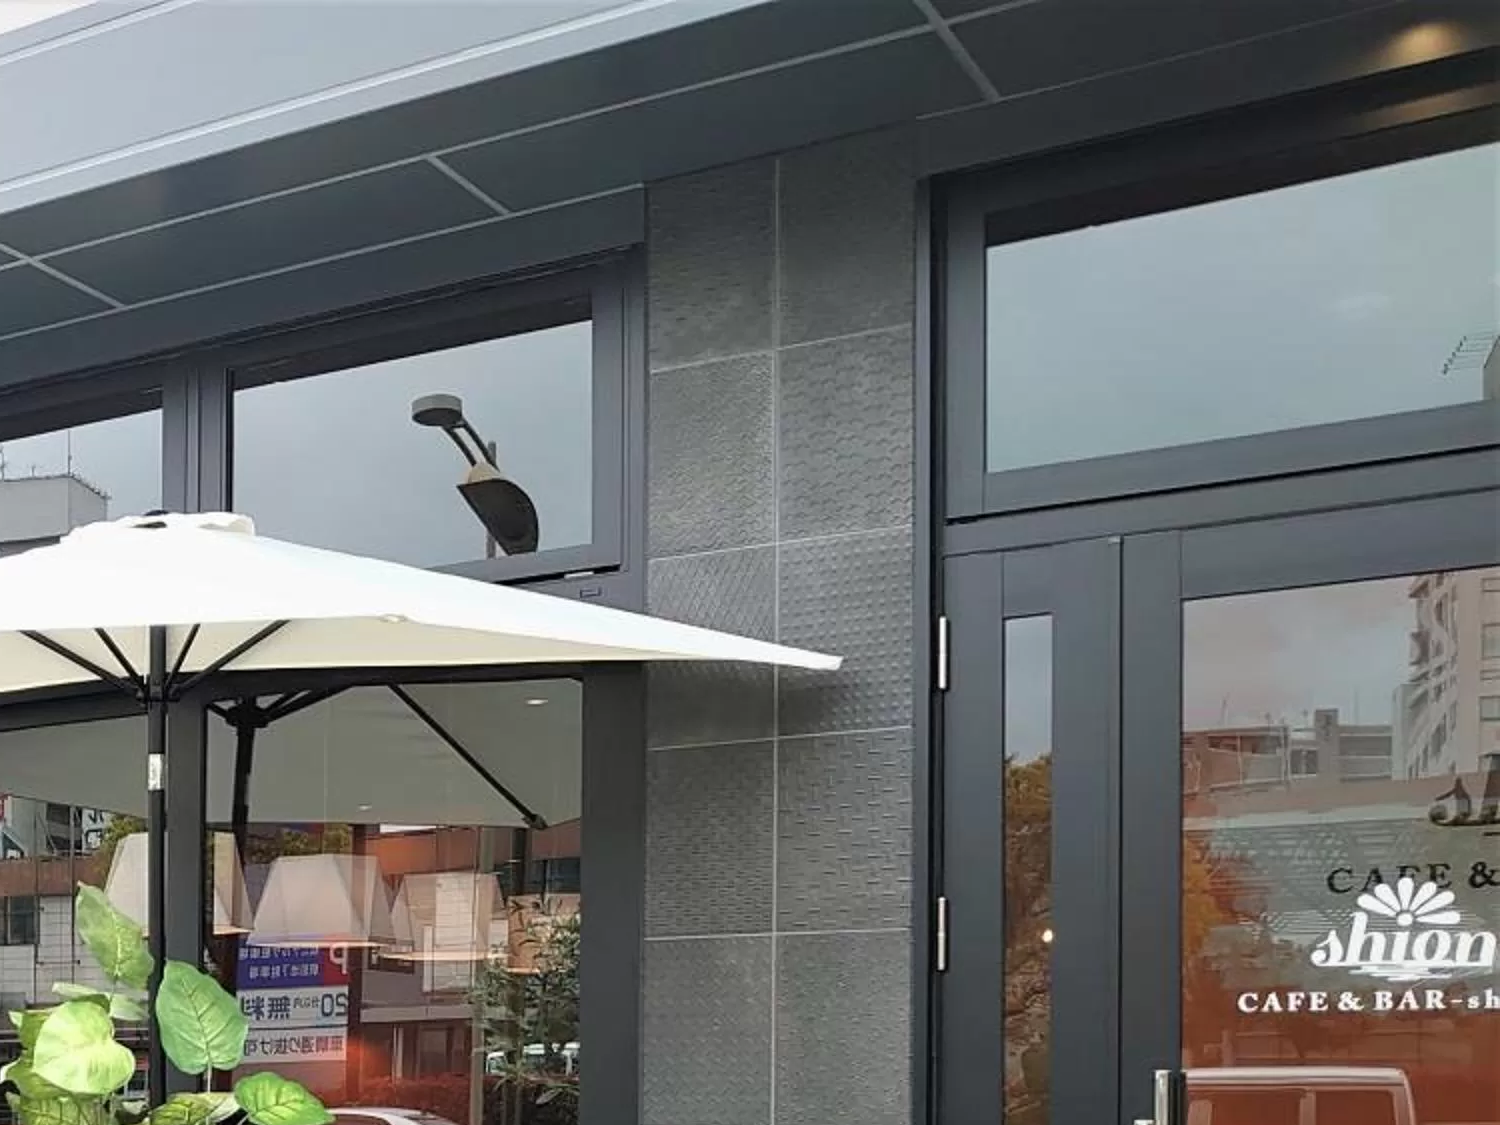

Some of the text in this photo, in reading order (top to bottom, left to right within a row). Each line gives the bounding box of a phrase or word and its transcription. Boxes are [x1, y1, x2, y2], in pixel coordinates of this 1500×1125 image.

[1468, 861, 1500, 888] &
[1310, 911, 1497, 968] shion
[1237, 991, 1329, 1013] CAFE
[1337, 991, 1365, 1012] &
